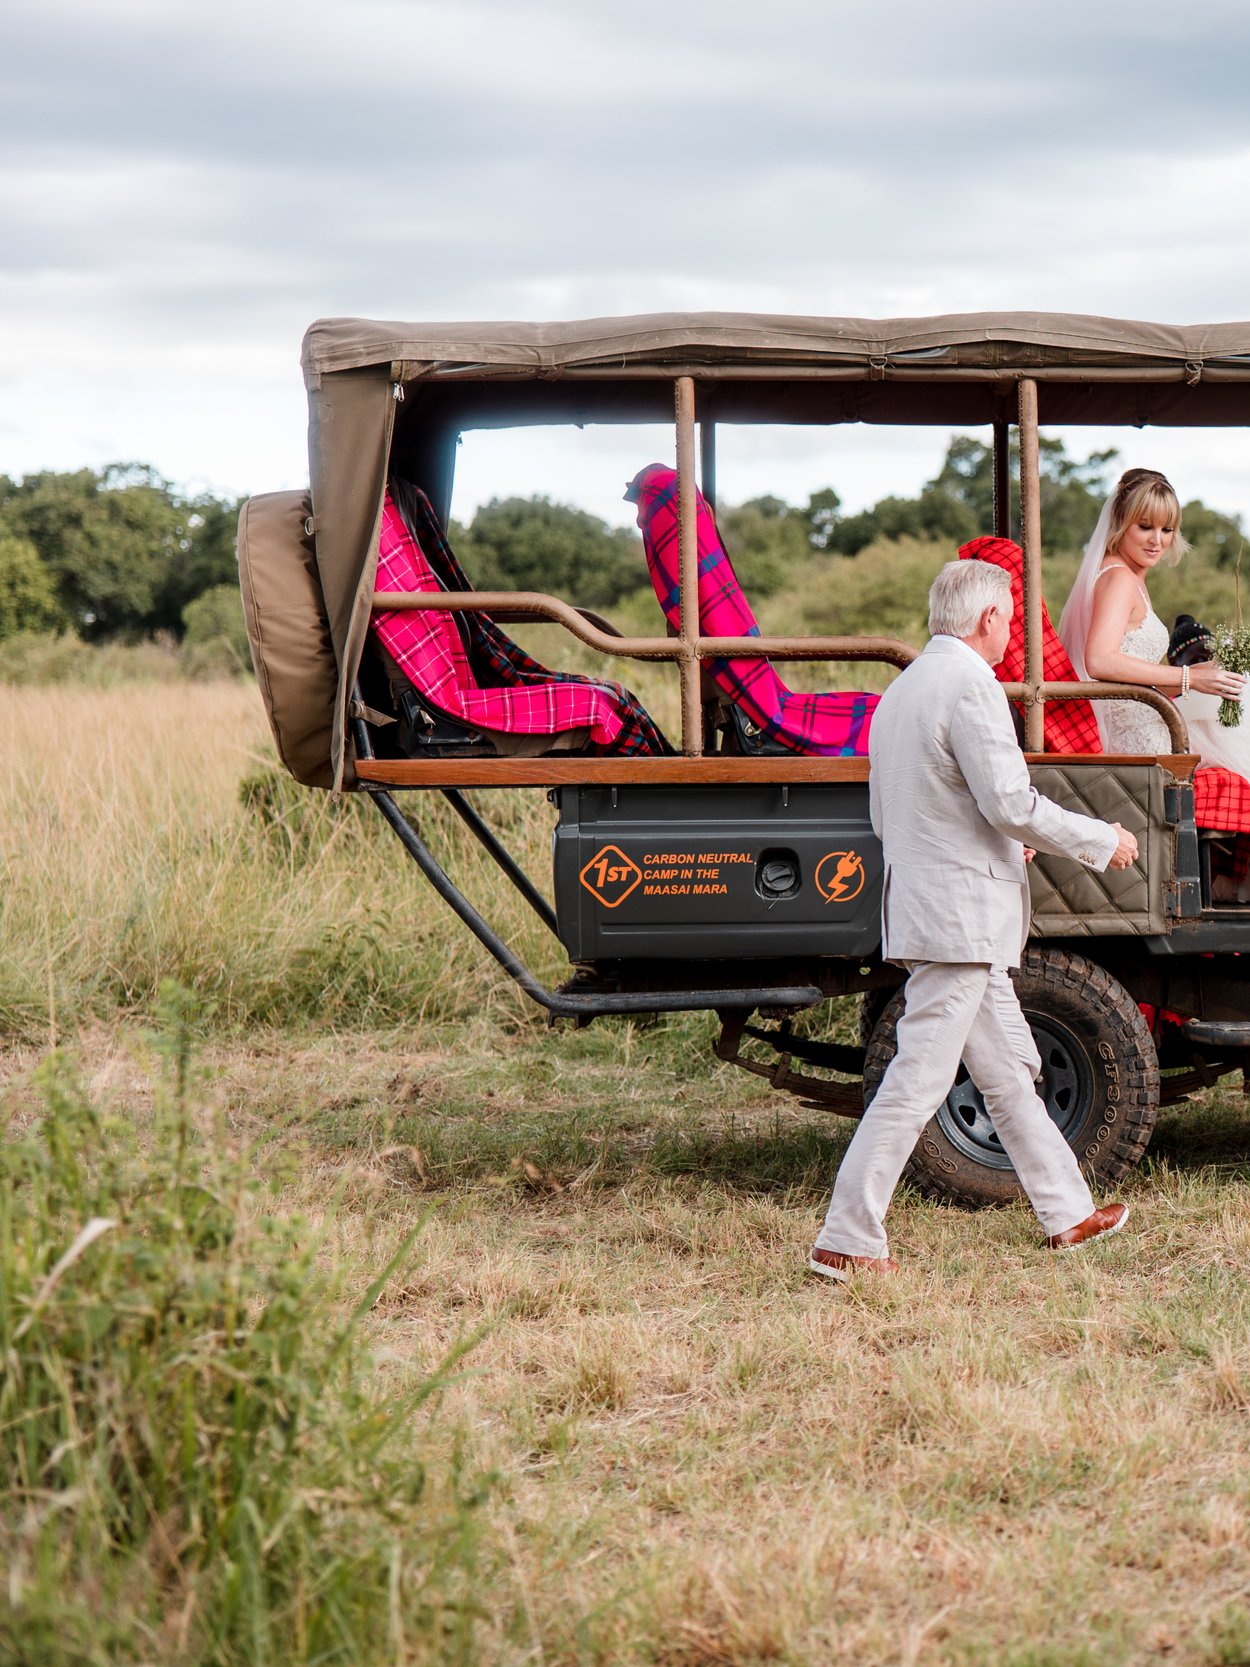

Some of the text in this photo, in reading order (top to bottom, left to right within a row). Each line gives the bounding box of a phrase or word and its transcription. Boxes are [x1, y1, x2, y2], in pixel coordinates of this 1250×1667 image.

[643, 853, 754, 865] CARBON NEUTRAL
[593, 858, 633, 888] 1ST
[643, 868, 720, 880] CAMP IN THE
[643, 884, 728, 896] MAASAI MARA
[1085, 1041, 1120, 1159] CF3000
